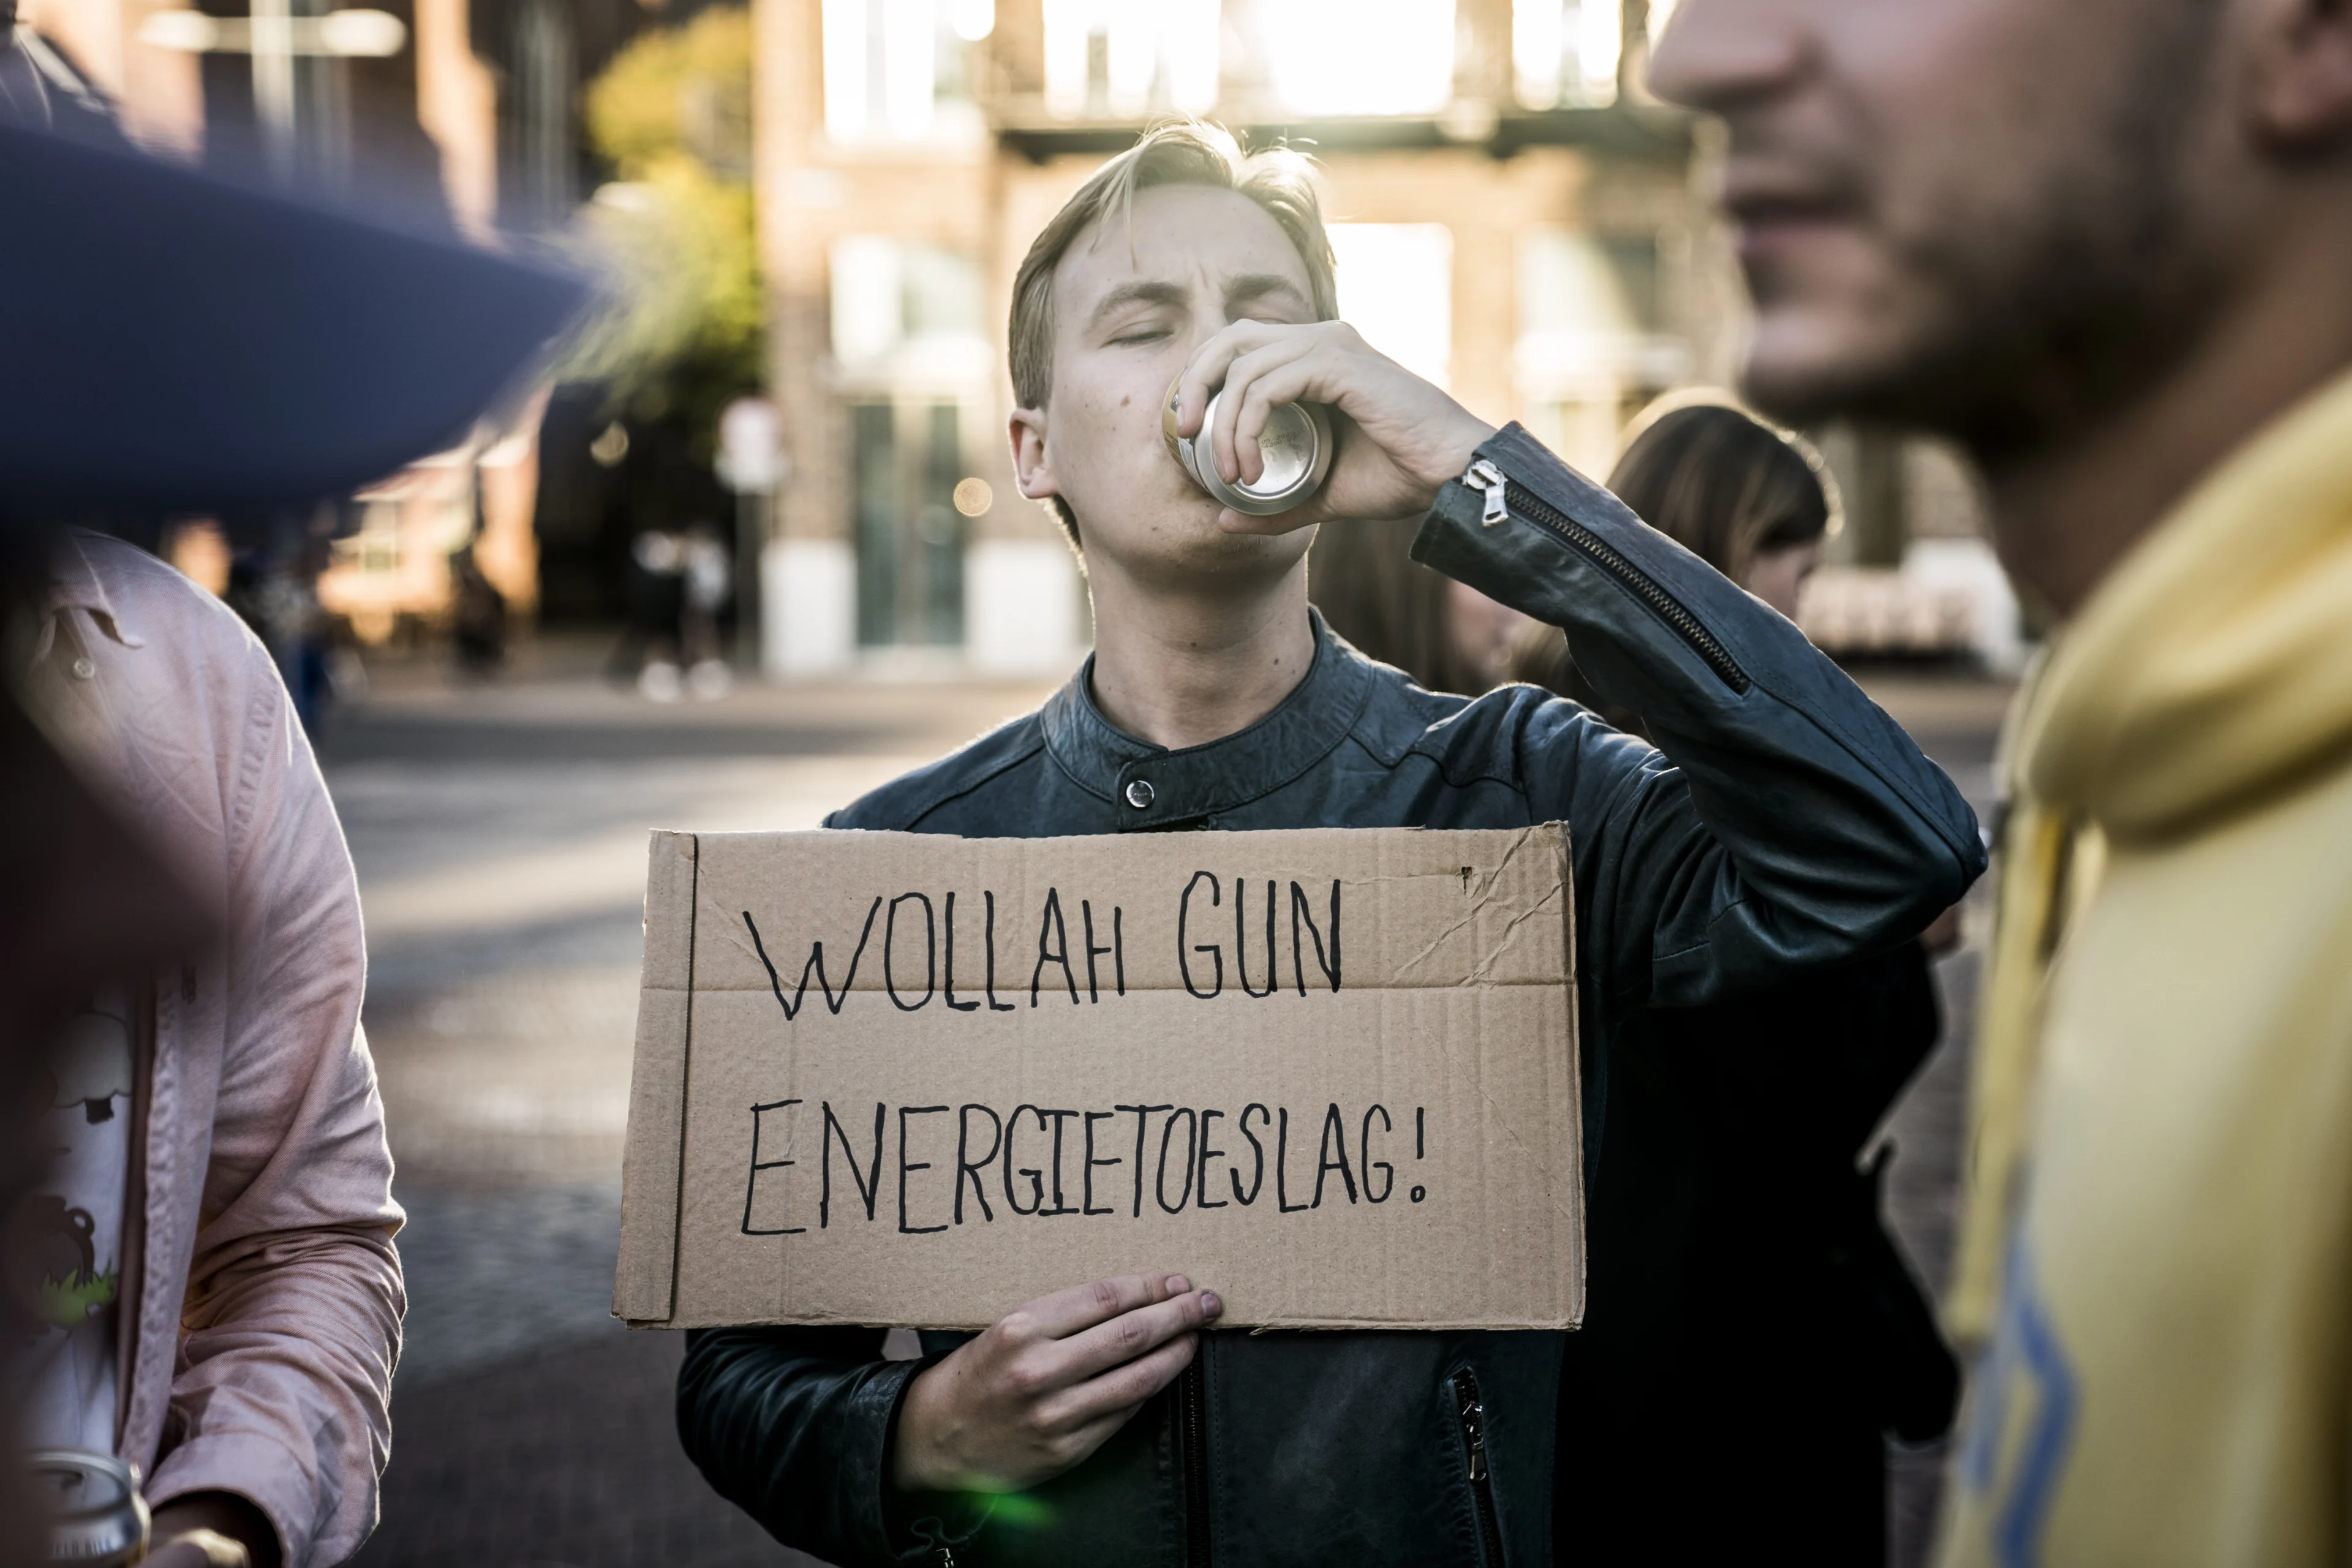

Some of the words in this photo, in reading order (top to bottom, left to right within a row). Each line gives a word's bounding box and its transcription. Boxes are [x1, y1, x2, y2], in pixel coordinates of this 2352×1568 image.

[742, 886, 1126, 1022] WOLLAH
[1177, 870, 1342, 1000] GUN
[740, 1098, 1427, 1237] ENERGIETOESLAG!
